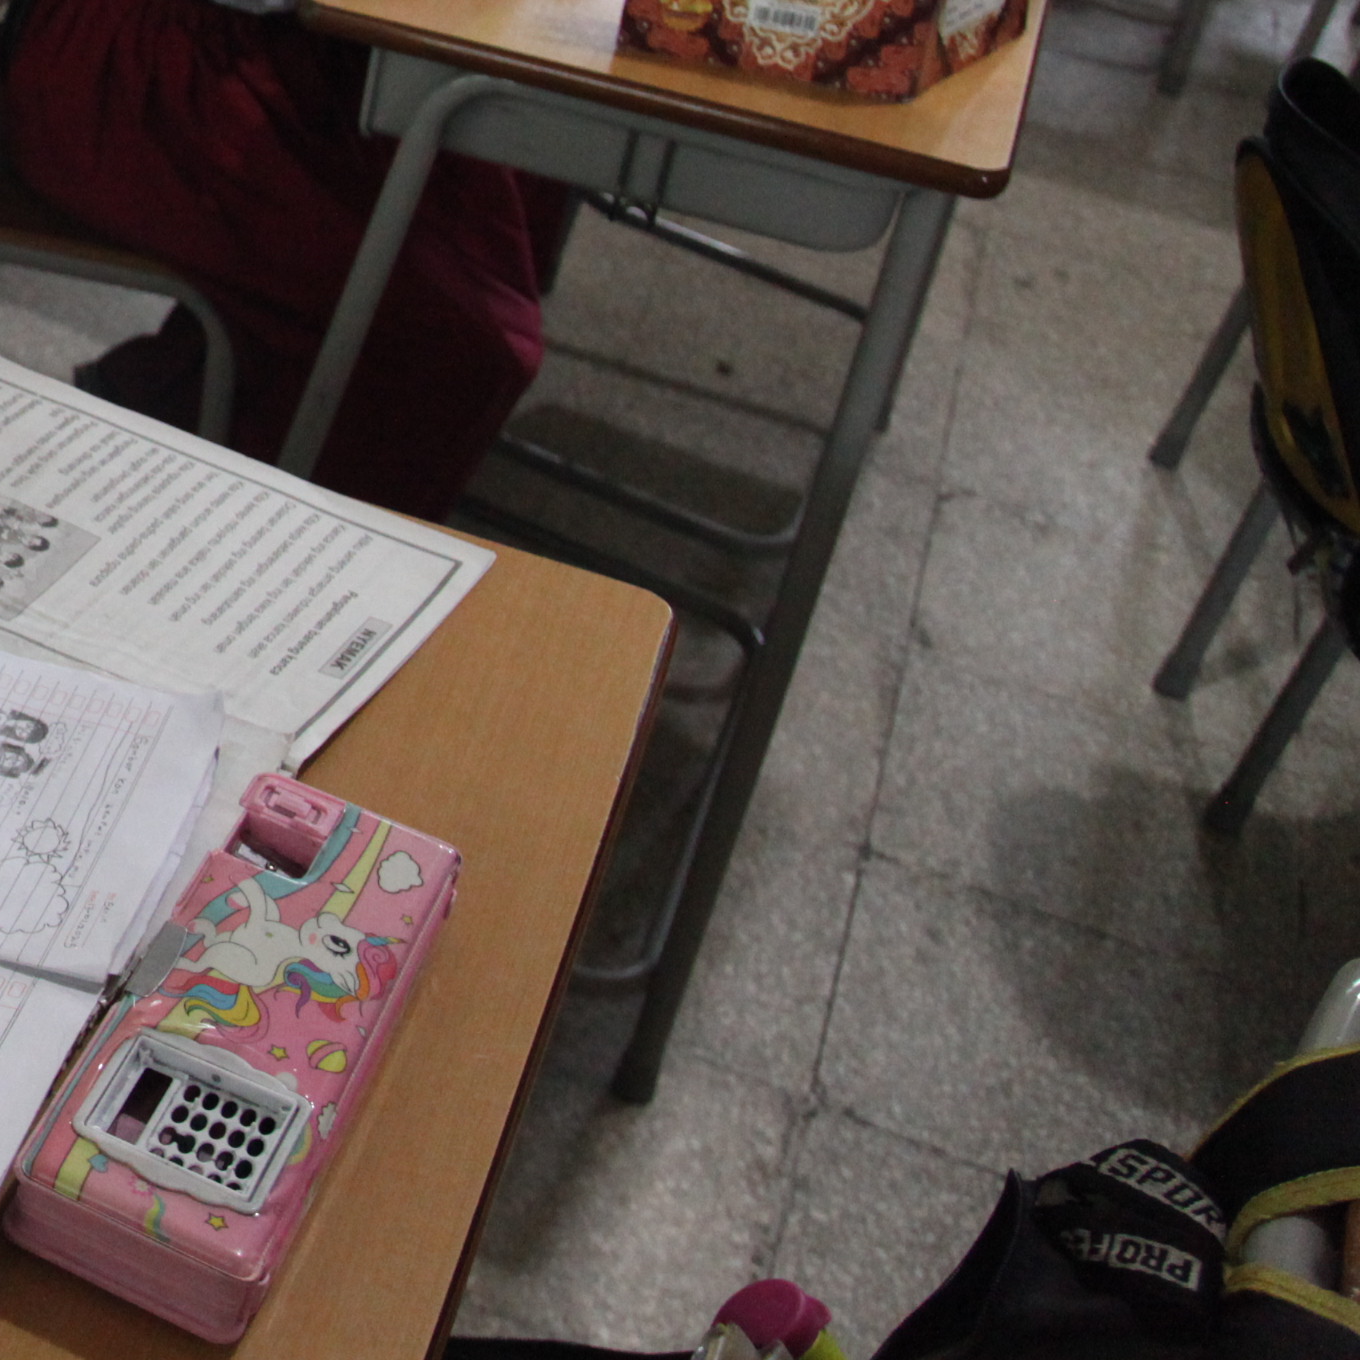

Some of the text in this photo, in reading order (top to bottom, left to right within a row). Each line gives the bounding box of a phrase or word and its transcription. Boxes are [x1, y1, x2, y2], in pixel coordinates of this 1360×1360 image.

[240, 525, 271, 549] bareng
[309, 541, 328, 554] ing
[229, 546, 250, 559] ing
[327, 549, 357, 573] seneng
[289, 553, 319, 577] sekolah
[264, 586, 285, 600] ing
[304, 571, 336, 597] amarga
[182, 591, 203, 604] ing
[262, 621, 287, 642] kanca
[267, 588, 359, 677] Pengalaman bareng kanca
[328, 627, 378, 671] NYEMAK
